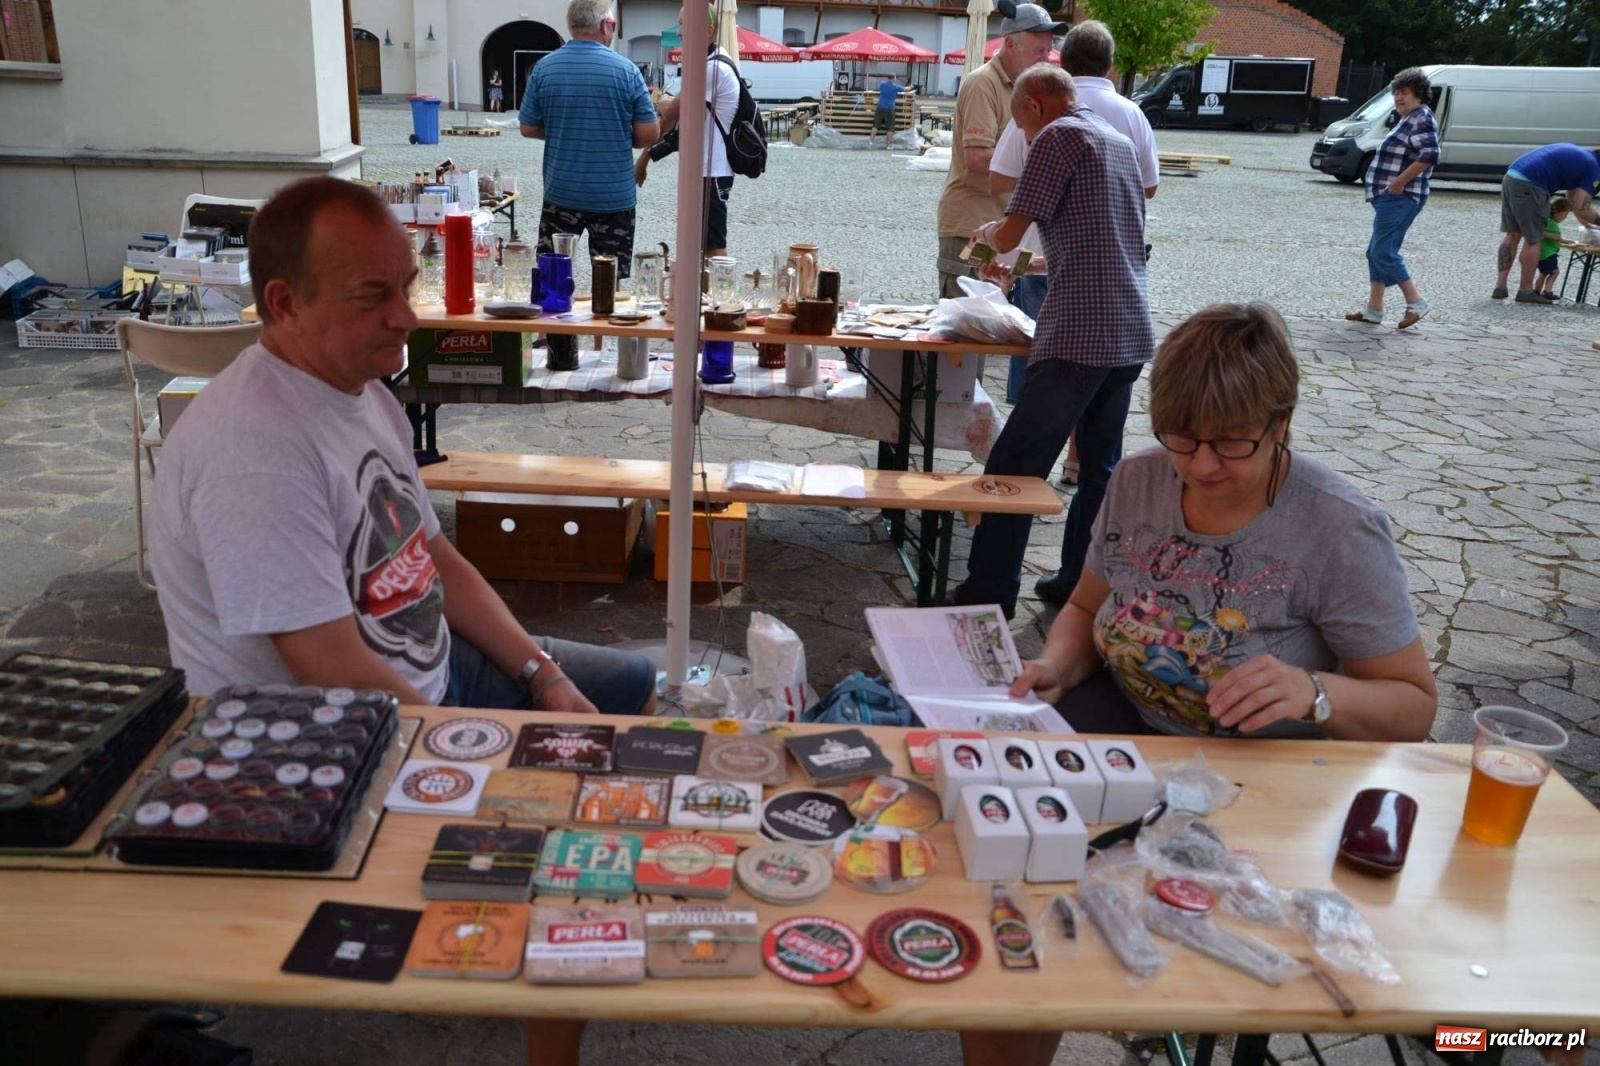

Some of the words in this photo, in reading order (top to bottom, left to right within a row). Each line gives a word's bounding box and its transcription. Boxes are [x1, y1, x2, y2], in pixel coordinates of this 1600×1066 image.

[442, 334, 488, 348] PERŁA
[564, 844, 632, 872] EPA
[552, 922, 623, 943] PERŁA
